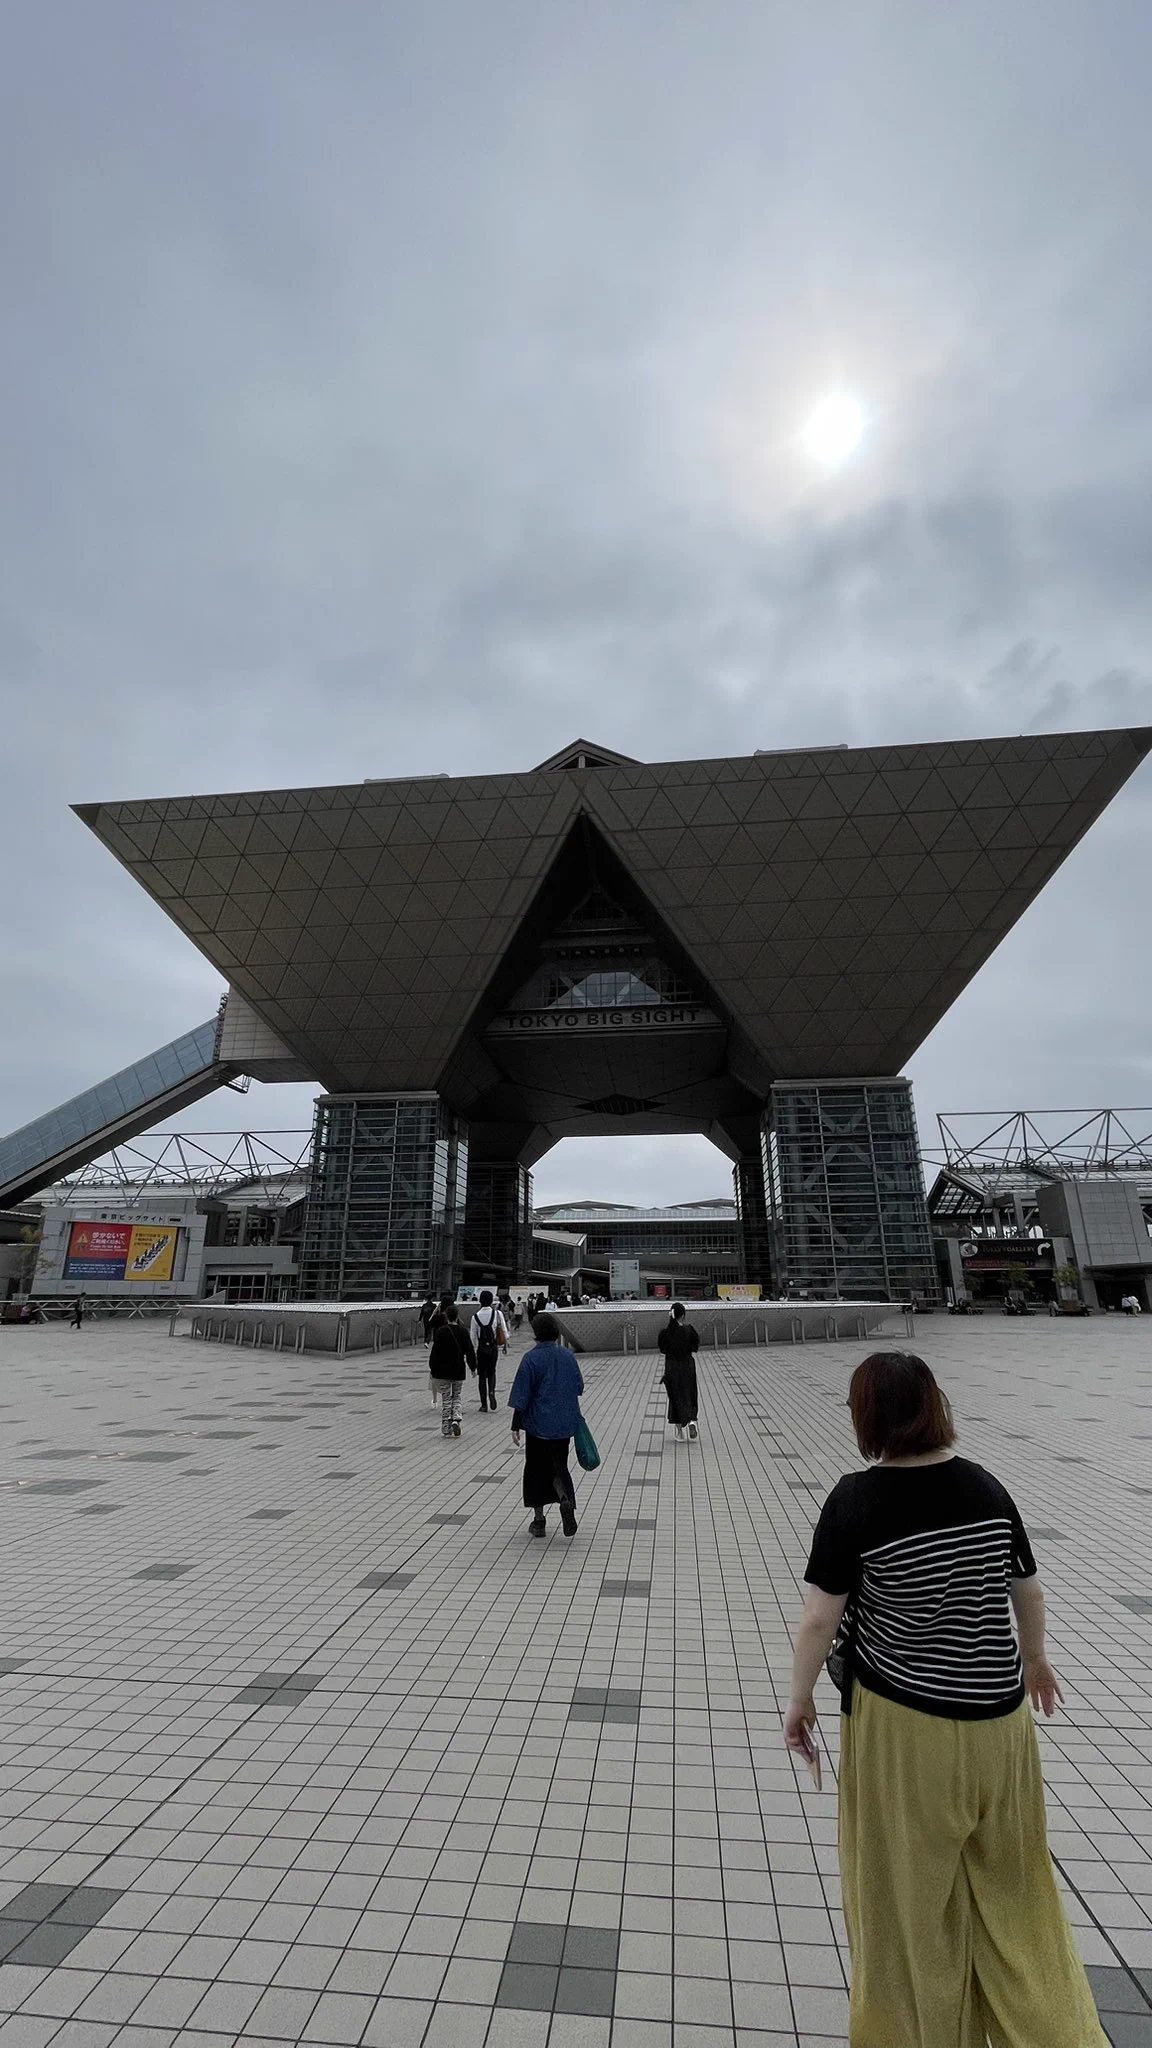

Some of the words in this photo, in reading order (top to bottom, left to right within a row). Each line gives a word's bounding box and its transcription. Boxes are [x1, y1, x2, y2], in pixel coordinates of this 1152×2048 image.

[506, 1014, 578, 1028] TOKYO
[587, 1012, 624, 1025] BIG
[631, 1009, 700, 1024] SIGHT
